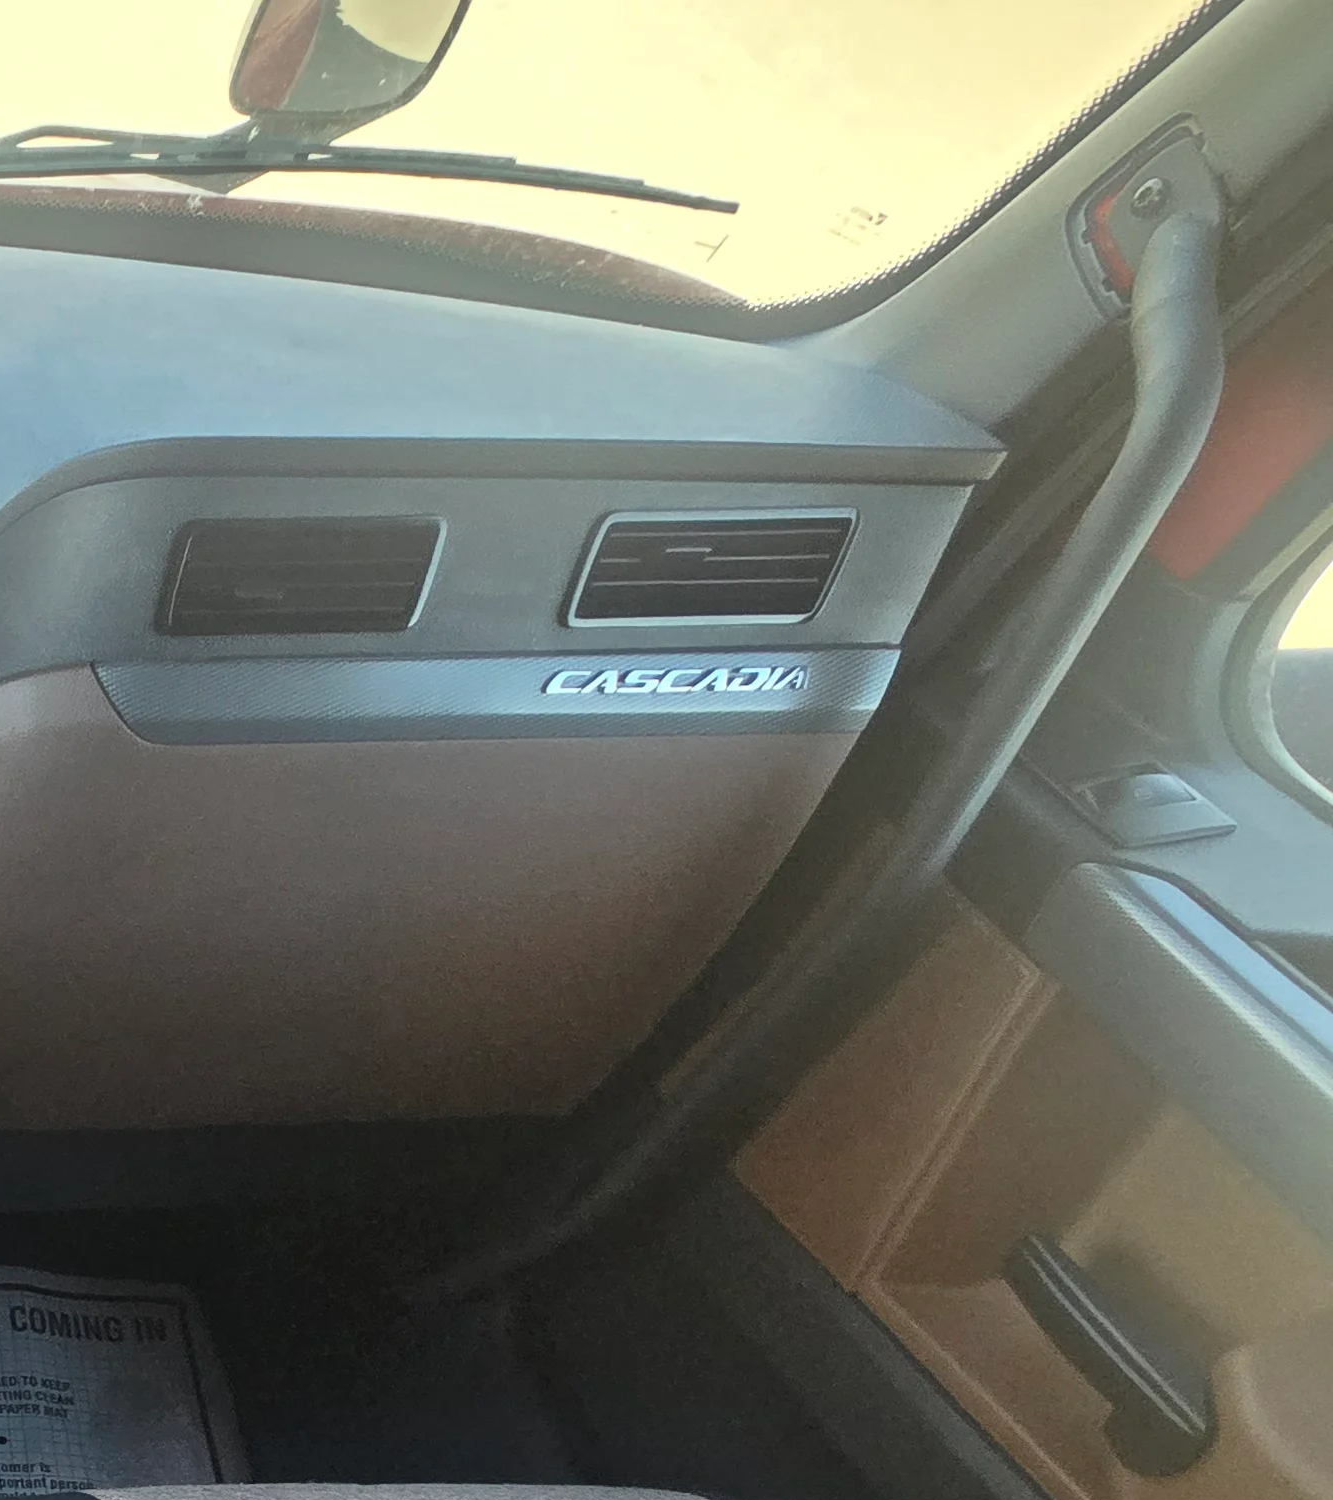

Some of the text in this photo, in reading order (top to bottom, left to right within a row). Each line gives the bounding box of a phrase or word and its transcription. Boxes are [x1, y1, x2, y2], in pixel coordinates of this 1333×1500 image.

[541, 666, 810, 694] CASCADIA
[9, 1305, 124, 1343] COMING
[134, 1316, 167, 1342] IN
[20, 1375, 38, 1388] TO
[0, 1403, 41, 1415] PAPER
